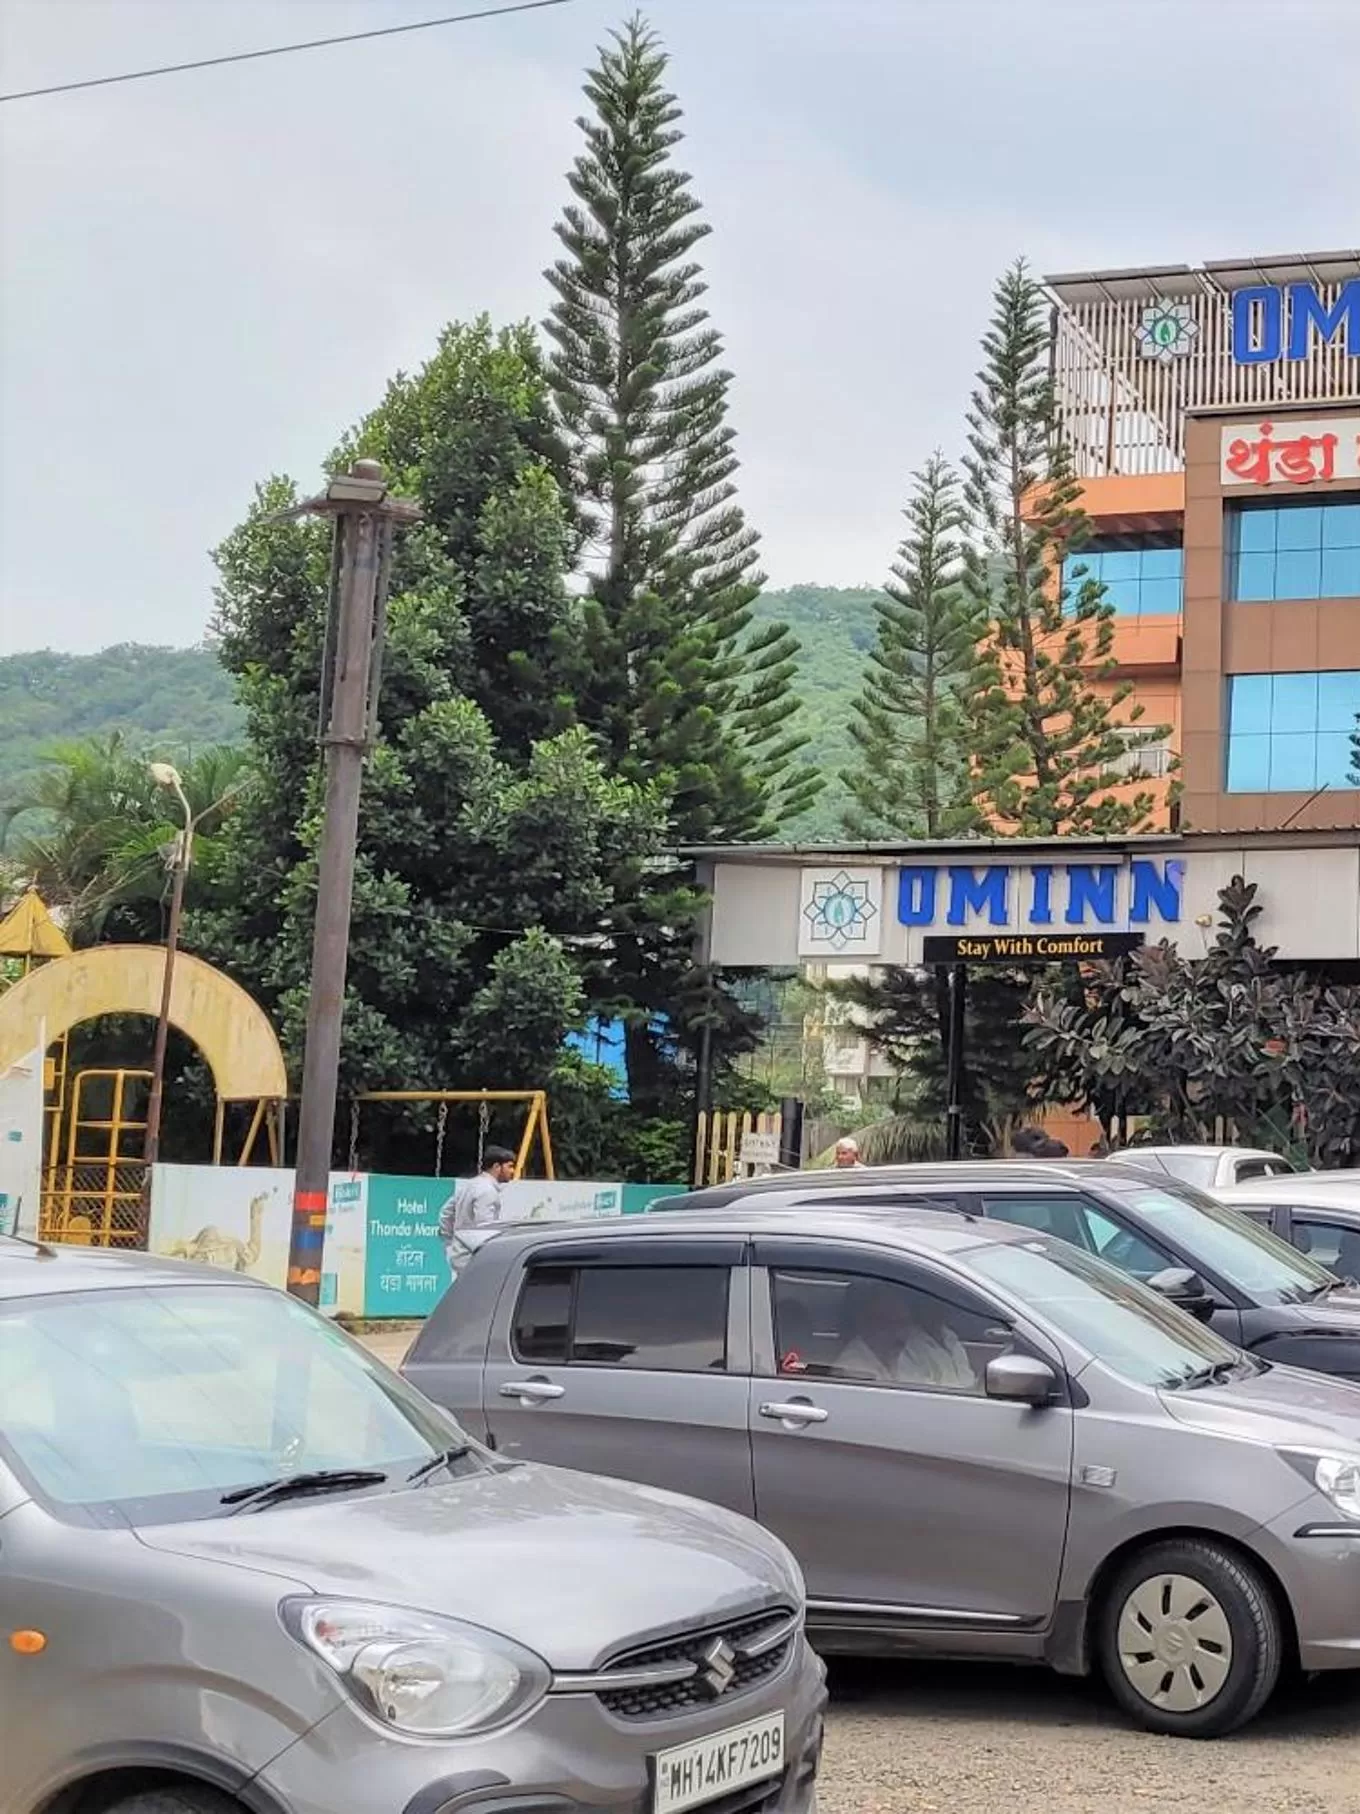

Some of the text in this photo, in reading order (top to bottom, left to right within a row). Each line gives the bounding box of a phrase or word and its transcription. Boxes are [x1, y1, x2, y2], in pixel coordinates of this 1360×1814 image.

[1225, 421, 1334, 487] थंडा
[898, 860, 1186, 927] OM INN
[957, 935, 1104, 958] Stay With Comfort
[396, 1197, 428, 1215] Hotel
[669, 1726, 782, 1801] MH14KF7209
